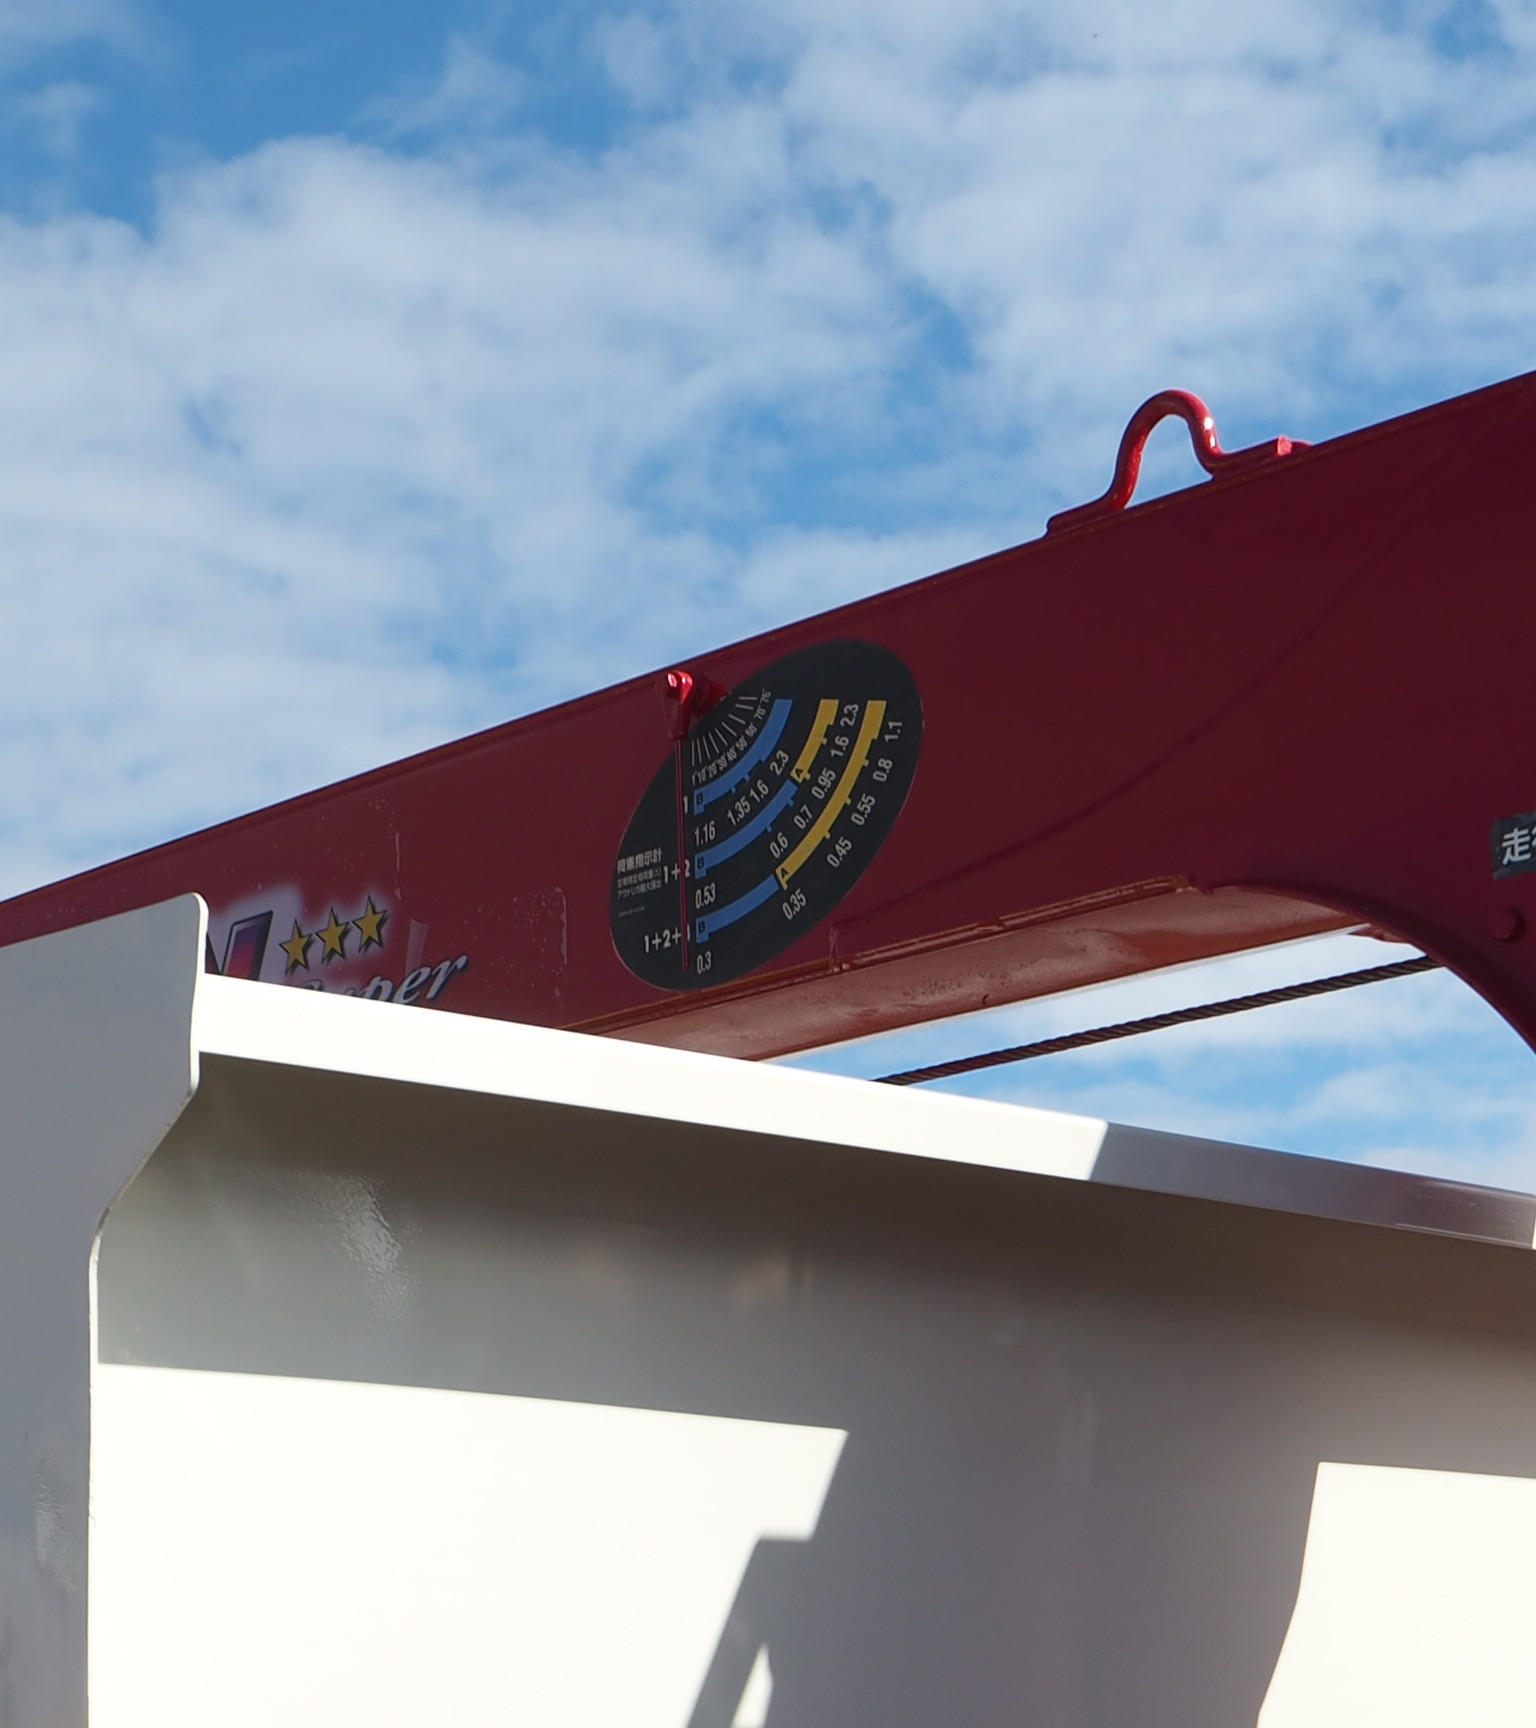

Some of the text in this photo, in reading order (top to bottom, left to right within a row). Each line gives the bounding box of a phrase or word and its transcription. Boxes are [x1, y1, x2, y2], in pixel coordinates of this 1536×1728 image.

[840, 703, 860, 727] 2.3
[884, 720, 903, 743] 1.1
[830, 735, 850, 758] 1.6
[769, 749, 789, 776] 2.3
[872, 757, 893, 783] 0.8
[749, 779, 769, 803] 1.6
[811, 767, 836, 800] 0.95
[727, 796, 751, 826] 1.35
[793, 804, 813, 830] 0.7
[851, 793, 876, 826] 0.55
[694, 820, 716, 846] 1.16
[769, 832, 789, 858] 0.6
[826, 836, 853, 868] 0.45
[695, 882, 716, 909] 0.53
[782, 888, 807, 920] 0.35
[696, 951, 712, 974] 0.3
